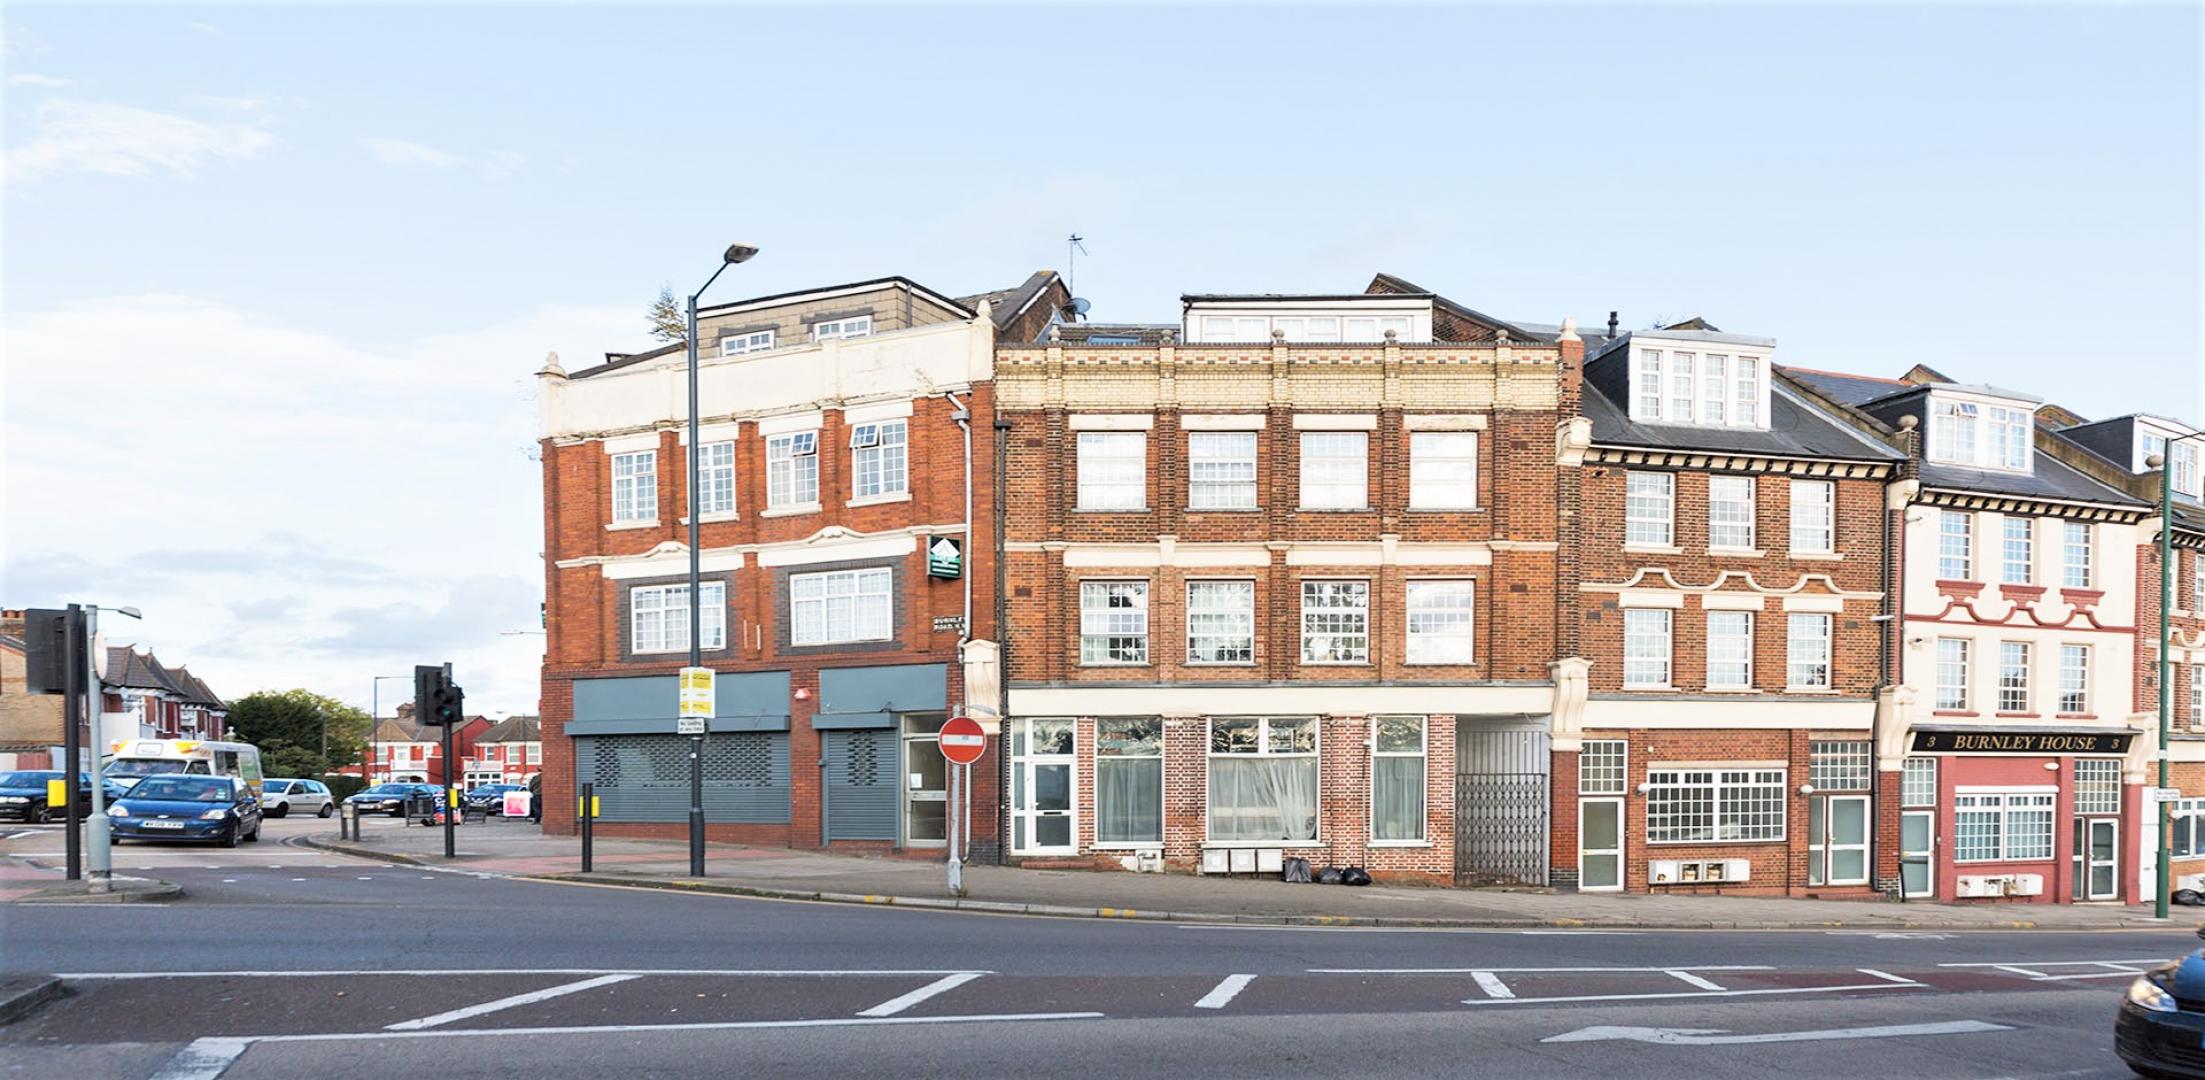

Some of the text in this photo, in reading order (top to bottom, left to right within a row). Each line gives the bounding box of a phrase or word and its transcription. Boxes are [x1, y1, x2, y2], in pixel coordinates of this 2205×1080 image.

[1927, 735, 2120, 750] 3 BURNLEY HOUSE 3
